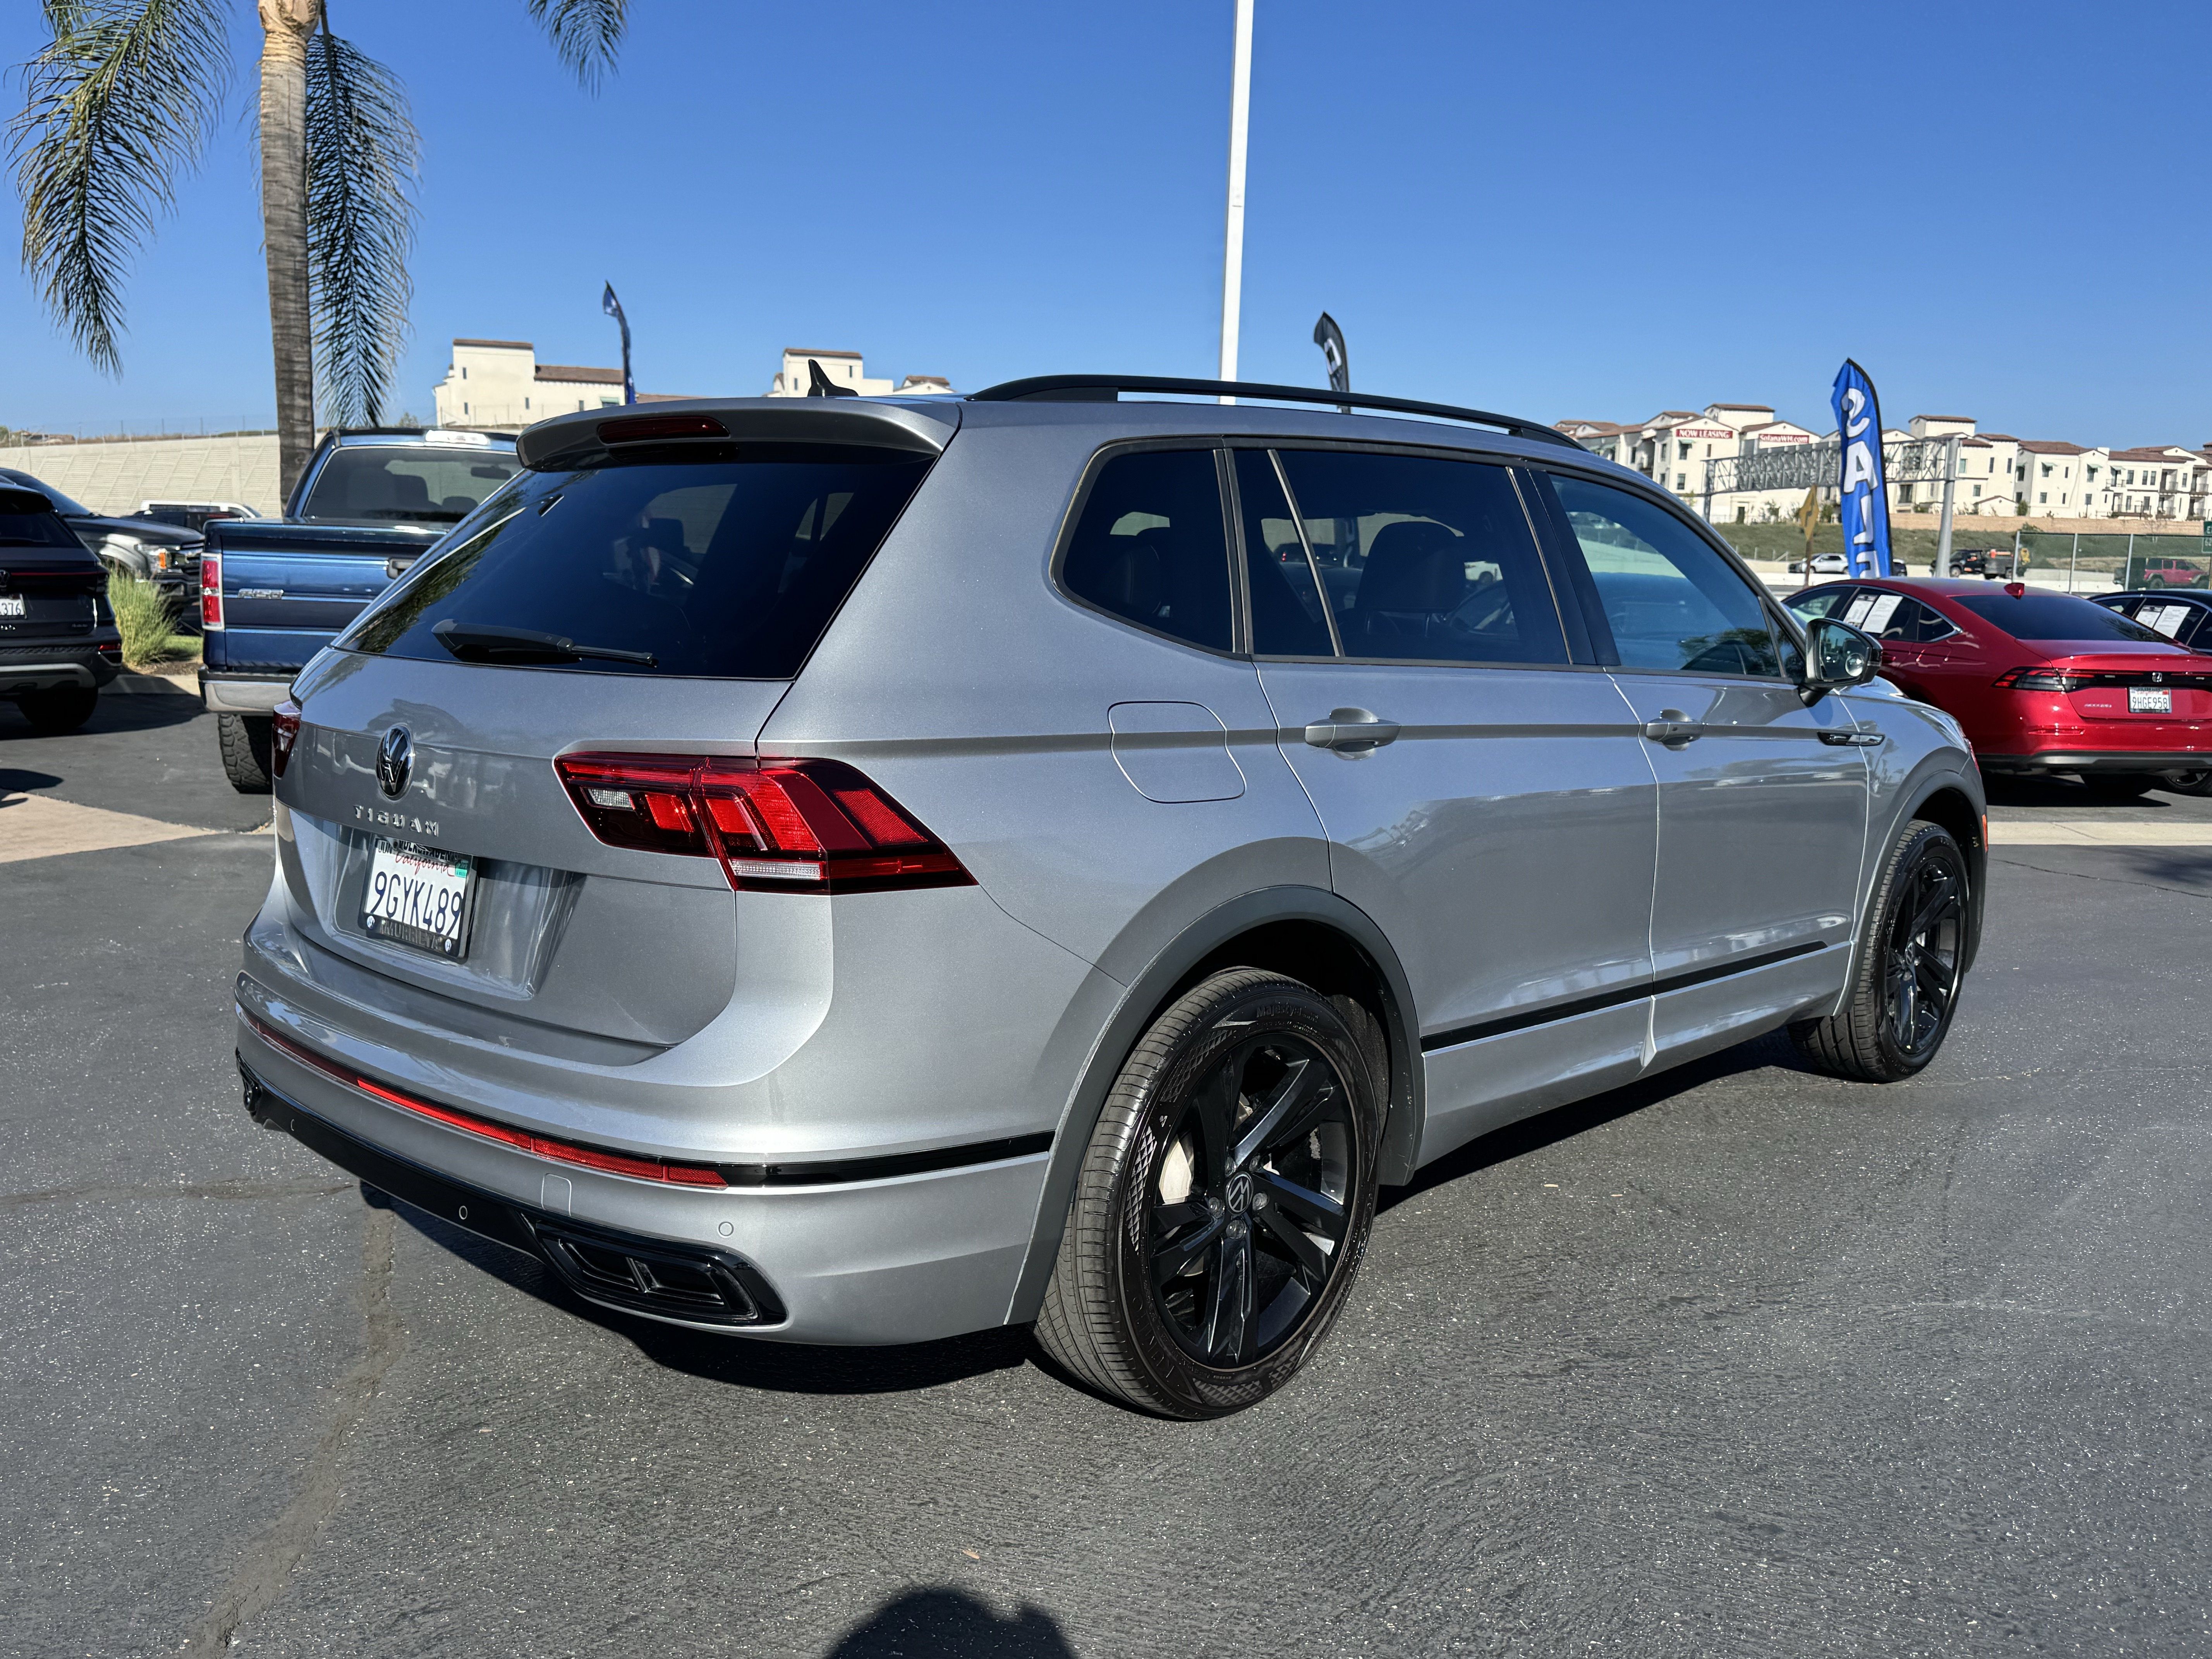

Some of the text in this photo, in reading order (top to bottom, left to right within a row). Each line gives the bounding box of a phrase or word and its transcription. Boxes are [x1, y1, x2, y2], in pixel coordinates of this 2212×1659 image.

[1679, 429, 1731, 439] NOW LEASING
[0, 603, 21, 615] 376
[2132, 697, 2168, 709] 9HGE958
[353, 805, 439, 837] TIGUAN
[370, 871, 464, 937] 9GYK489
